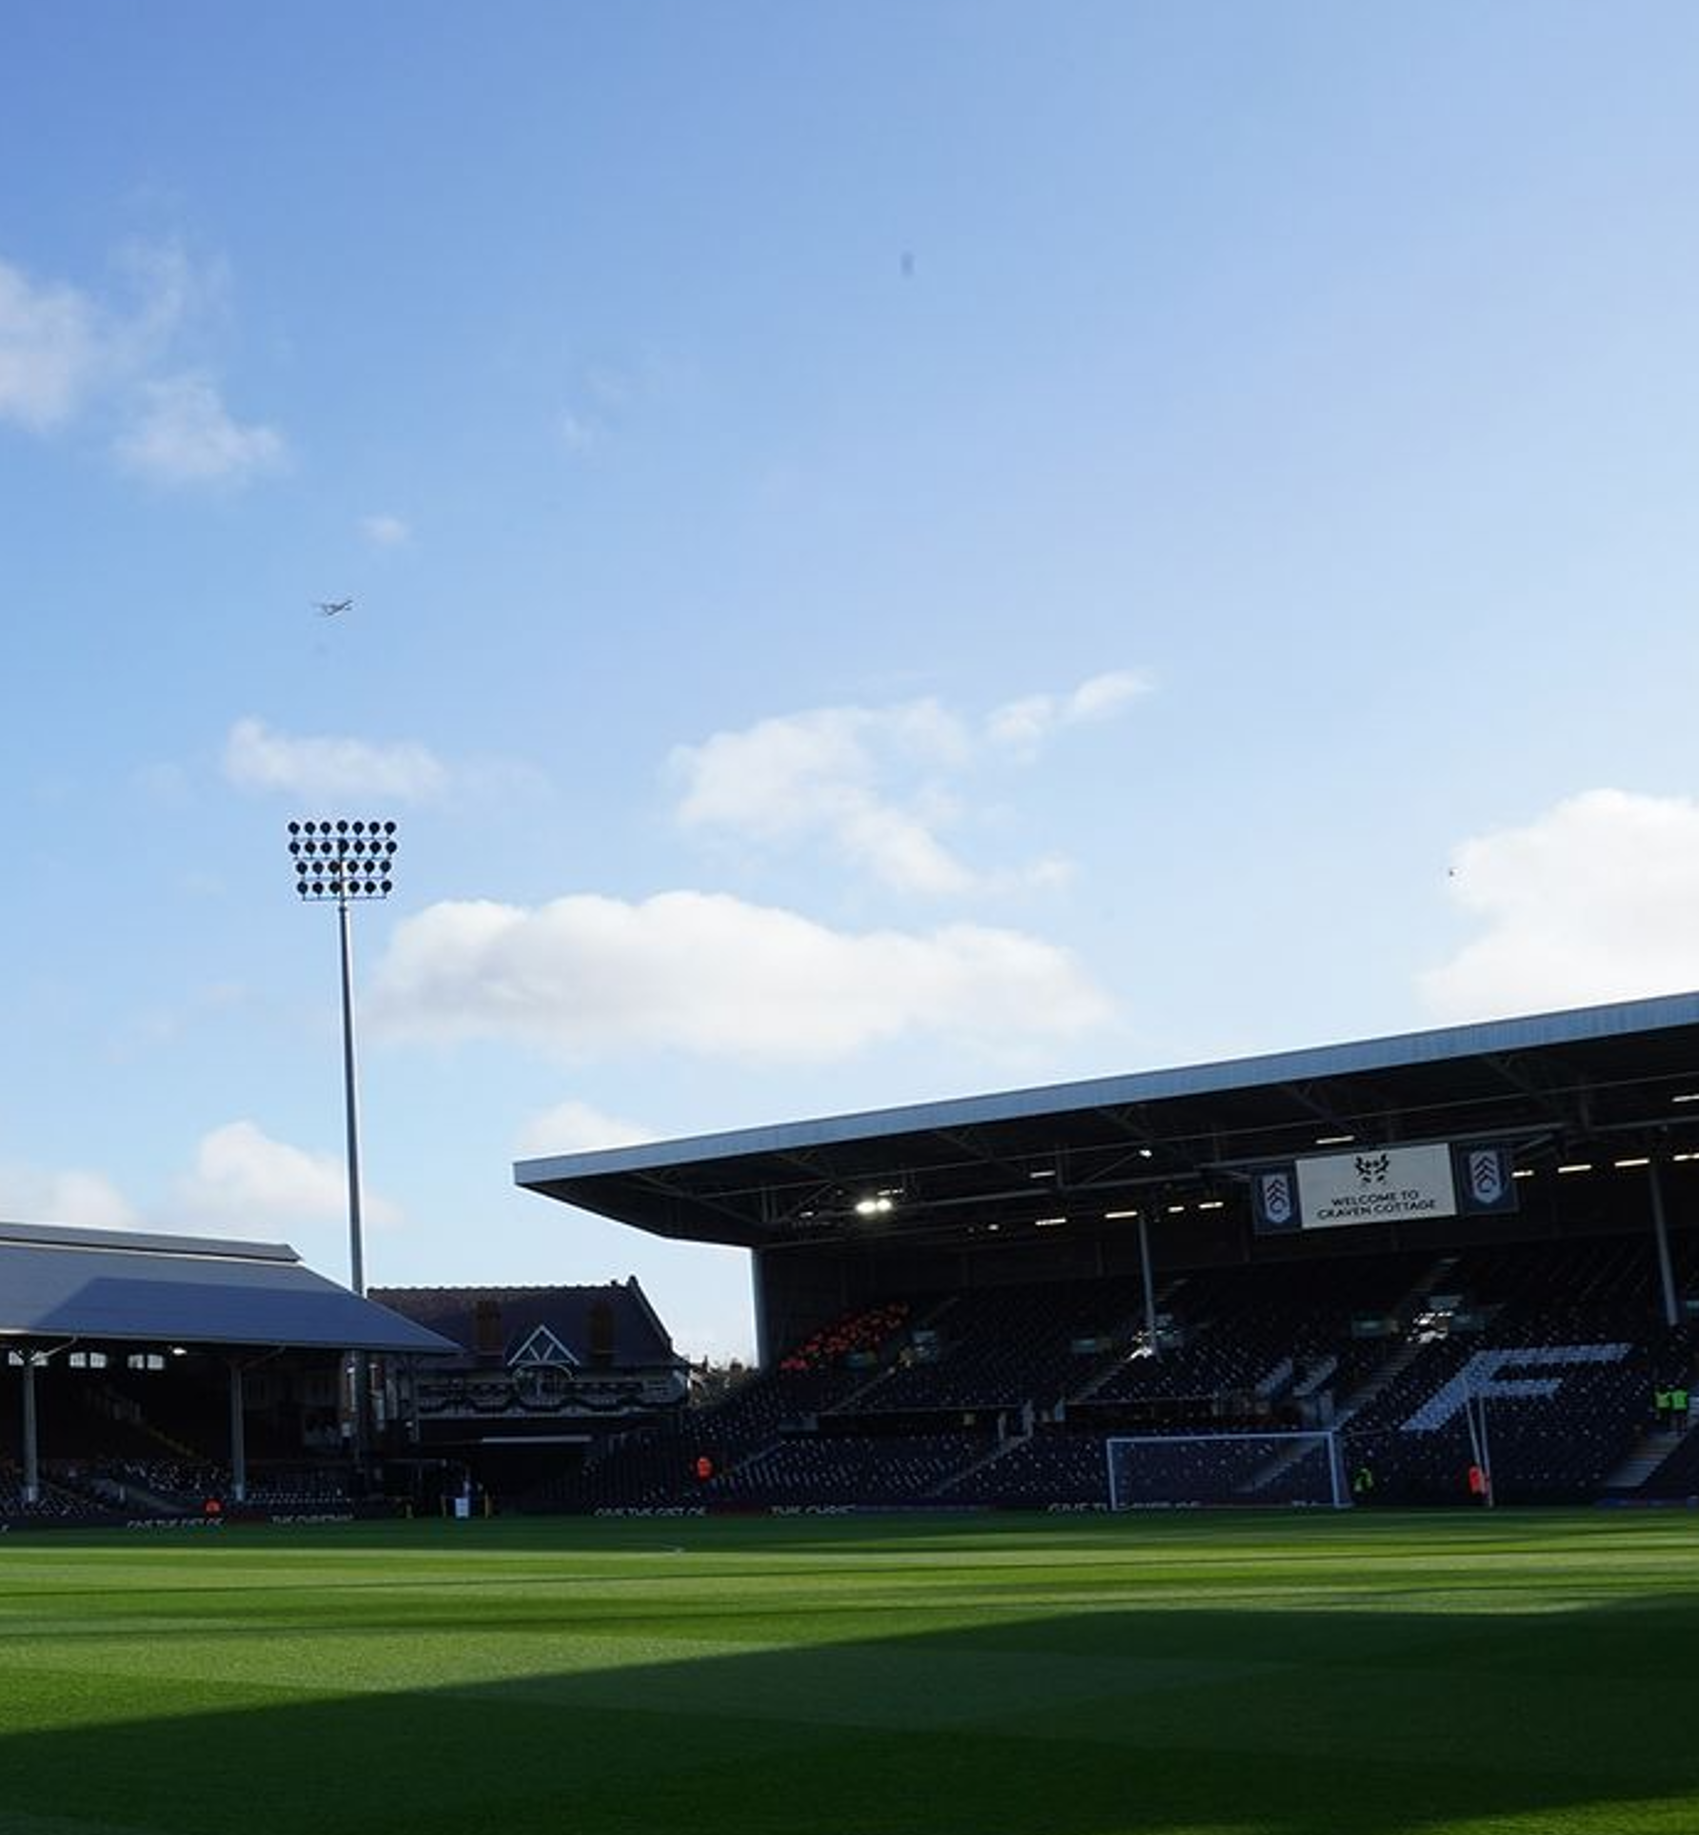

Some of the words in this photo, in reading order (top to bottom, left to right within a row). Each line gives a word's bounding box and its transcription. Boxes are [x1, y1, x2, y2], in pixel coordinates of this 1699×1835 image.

[1330, 1191, 1397, 1208] WELCOME
[1400, 1189, 1419, 1200] TO
[1317, 1204, 1371, 1220] CRAVEN
[1374, 1198, 1437, 1215] COTTAGE
